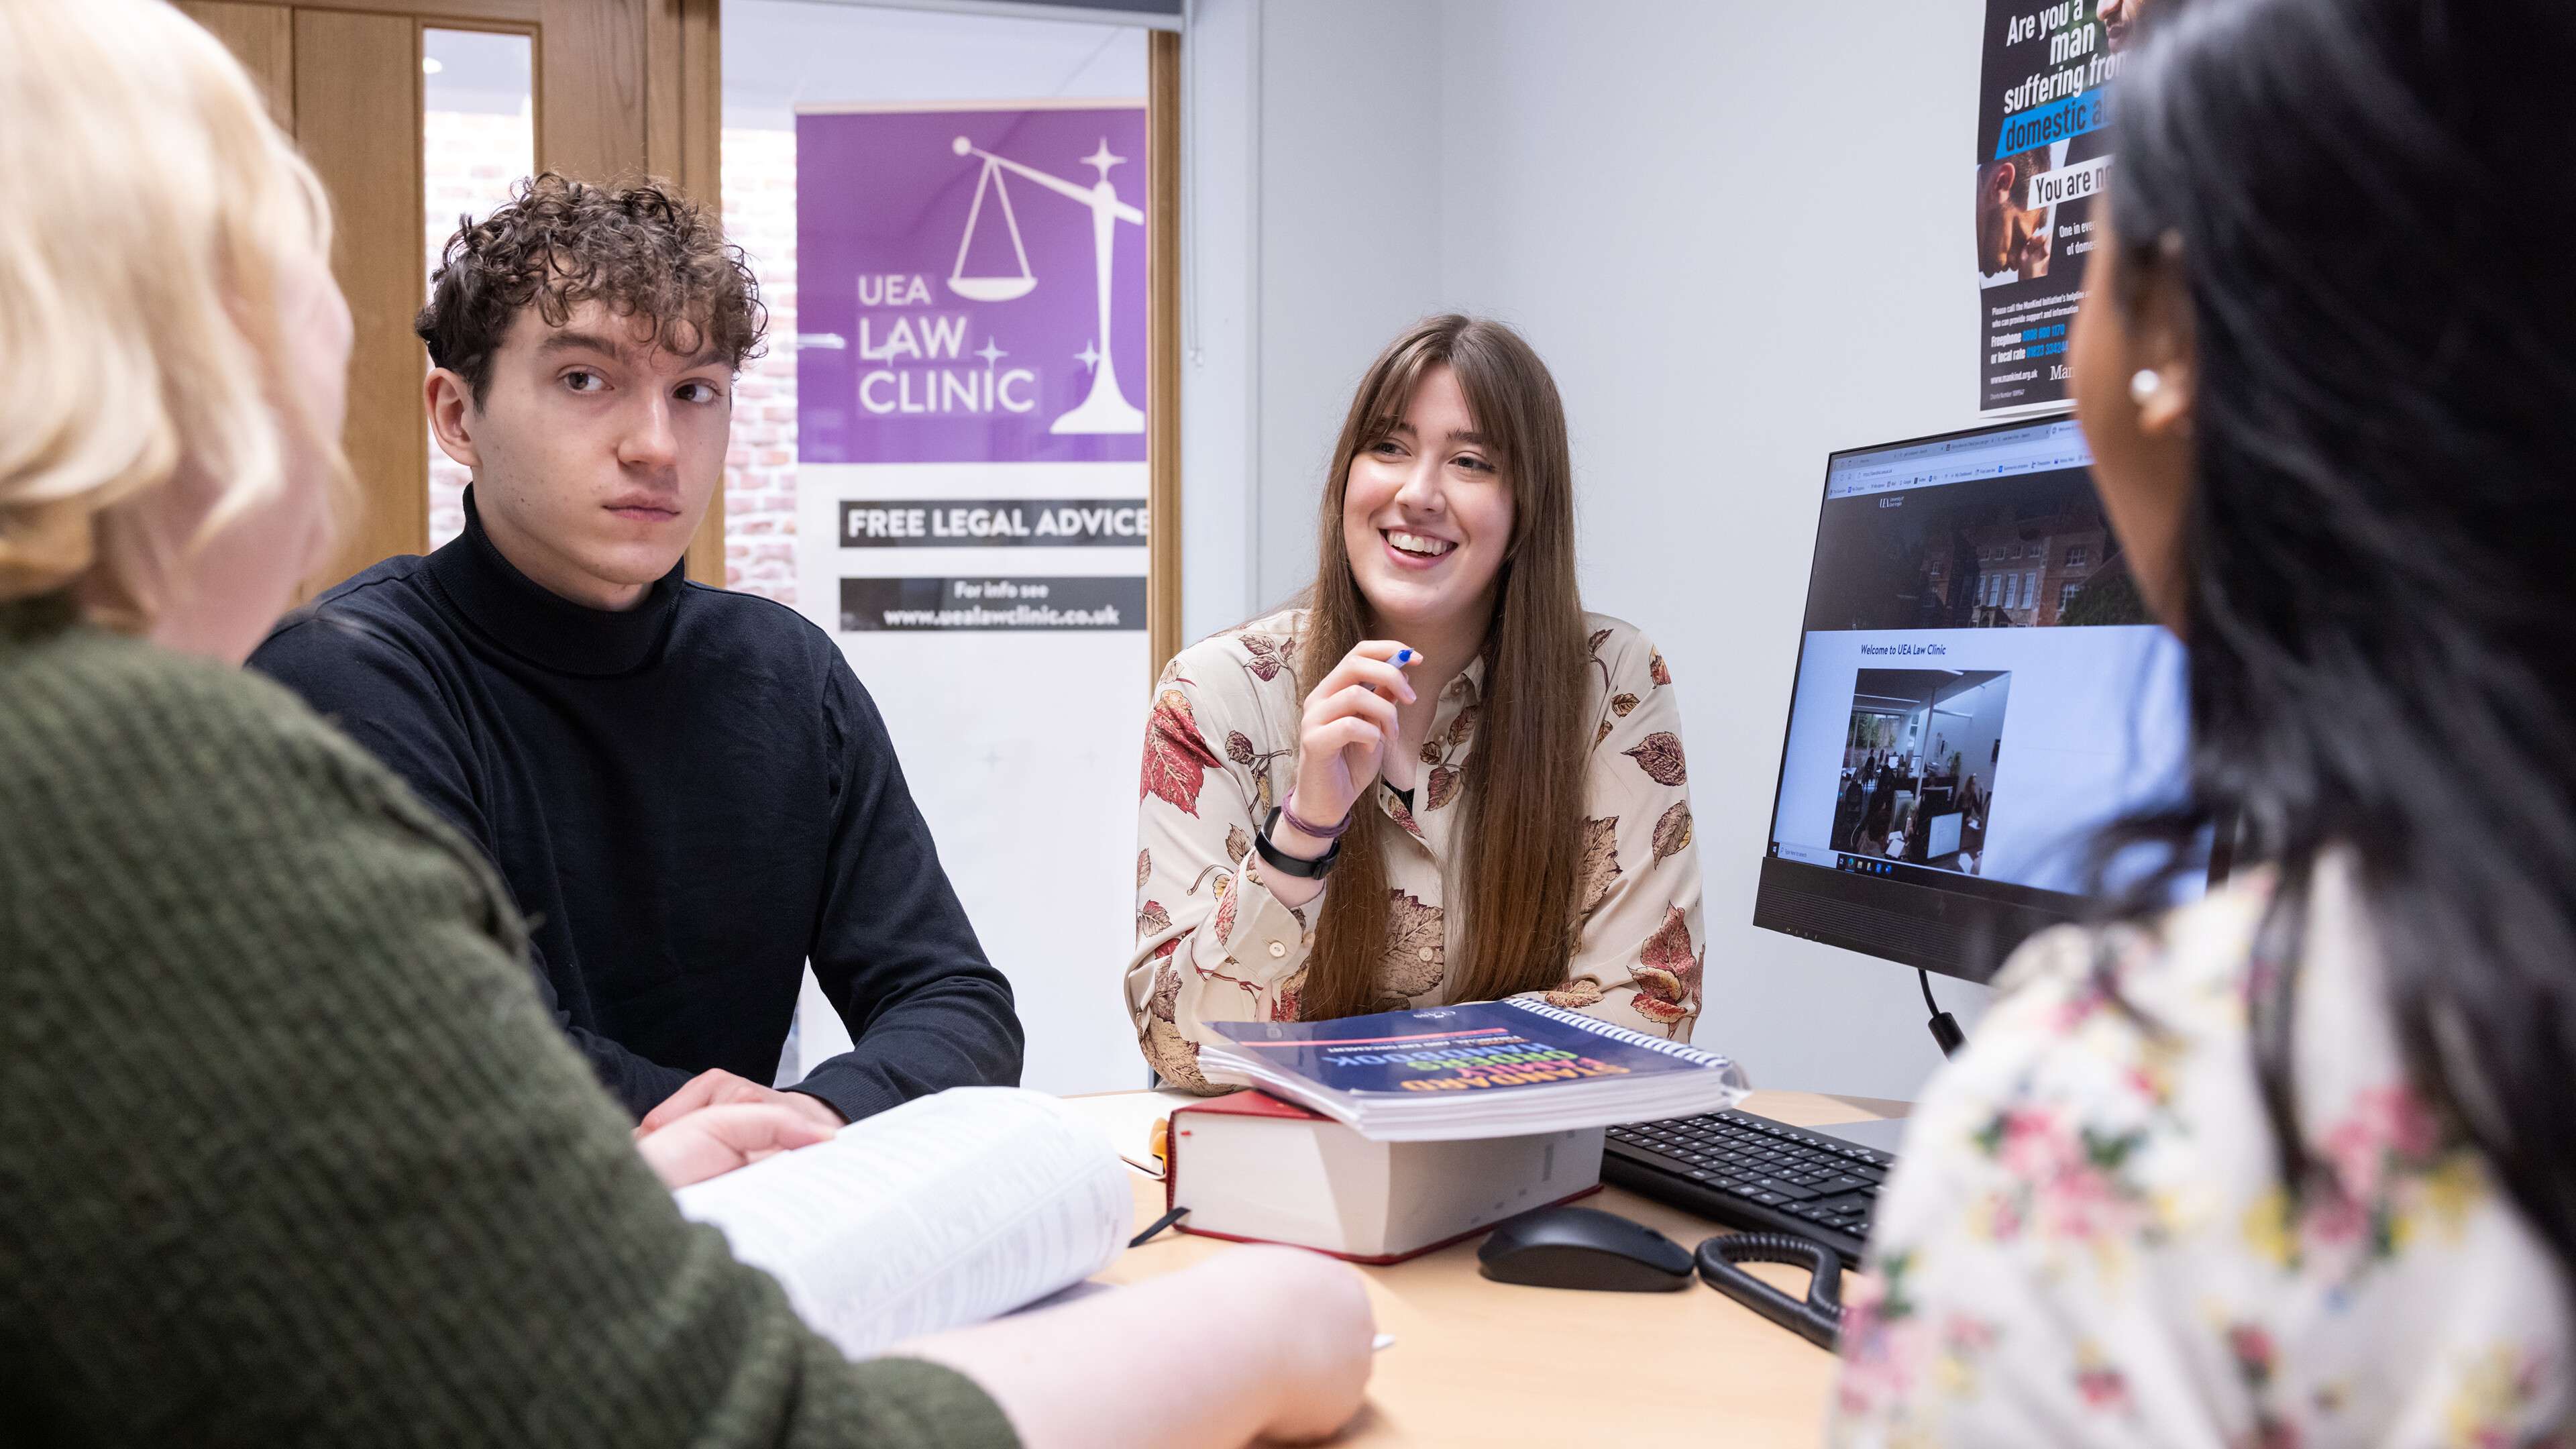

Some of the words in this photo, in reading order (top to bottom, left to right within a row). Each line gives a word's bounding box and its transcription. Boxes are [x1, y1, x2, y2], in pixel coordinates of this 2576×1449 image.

[2006, 15, 2035, 47] Are
[2039, 1, 2070, 41] you
[2073, 0, 2084, 21] a
[2049, 22, 2096, 66] man
[2004, 65, 2085, 114] suffering
[2006, 103, 2086, 152] domestic
[2036, 177, 2061, 203] You
[2067, 171, 2091, 196] are
[2059, 225, 2073, 237] One
[2073, 222, 2080, 235] in
[2066, 242, 2074, 256] of
[859, 274, 932, 305] UEA
[860, 316, 967, 360] LAW
[1991, 333, 2022, 347] Freephone
[1990, 354, 1998, 364] or
[1998, 350, 2012, 364] local
[2012, 347, 2026, 361] rate
[859, 369, 1035, 414] CLINIC
[848, 508, 926, 537] FREE
[932, 508, 1031, 537] LEGAL
[1034, 507, 1152, 537] ADVICE
[953, 580, 982, 598] For
[983, 580, 1018, 598] info
[1019, 583, 1050, 598] see
[883, 604, 1120, 626] www.uealawclinic.co.uk
[1860, 644, 1888, 655] Welcome
[1889, 645, 1896, 655] to
[1898, 644, 1912, 655] UEA
[1913, 644, 1927, 655] Law
[1927, 644, 1946, 655] Clinic
[1322, 1042, 1556, 1067] HANDBOOK
[1408, 1050, 1578, 1072] ORDERS
[1400, 1064, 1631, 1092] STANDARD
[1456, 1057, 1607, 1079] FAMILY
